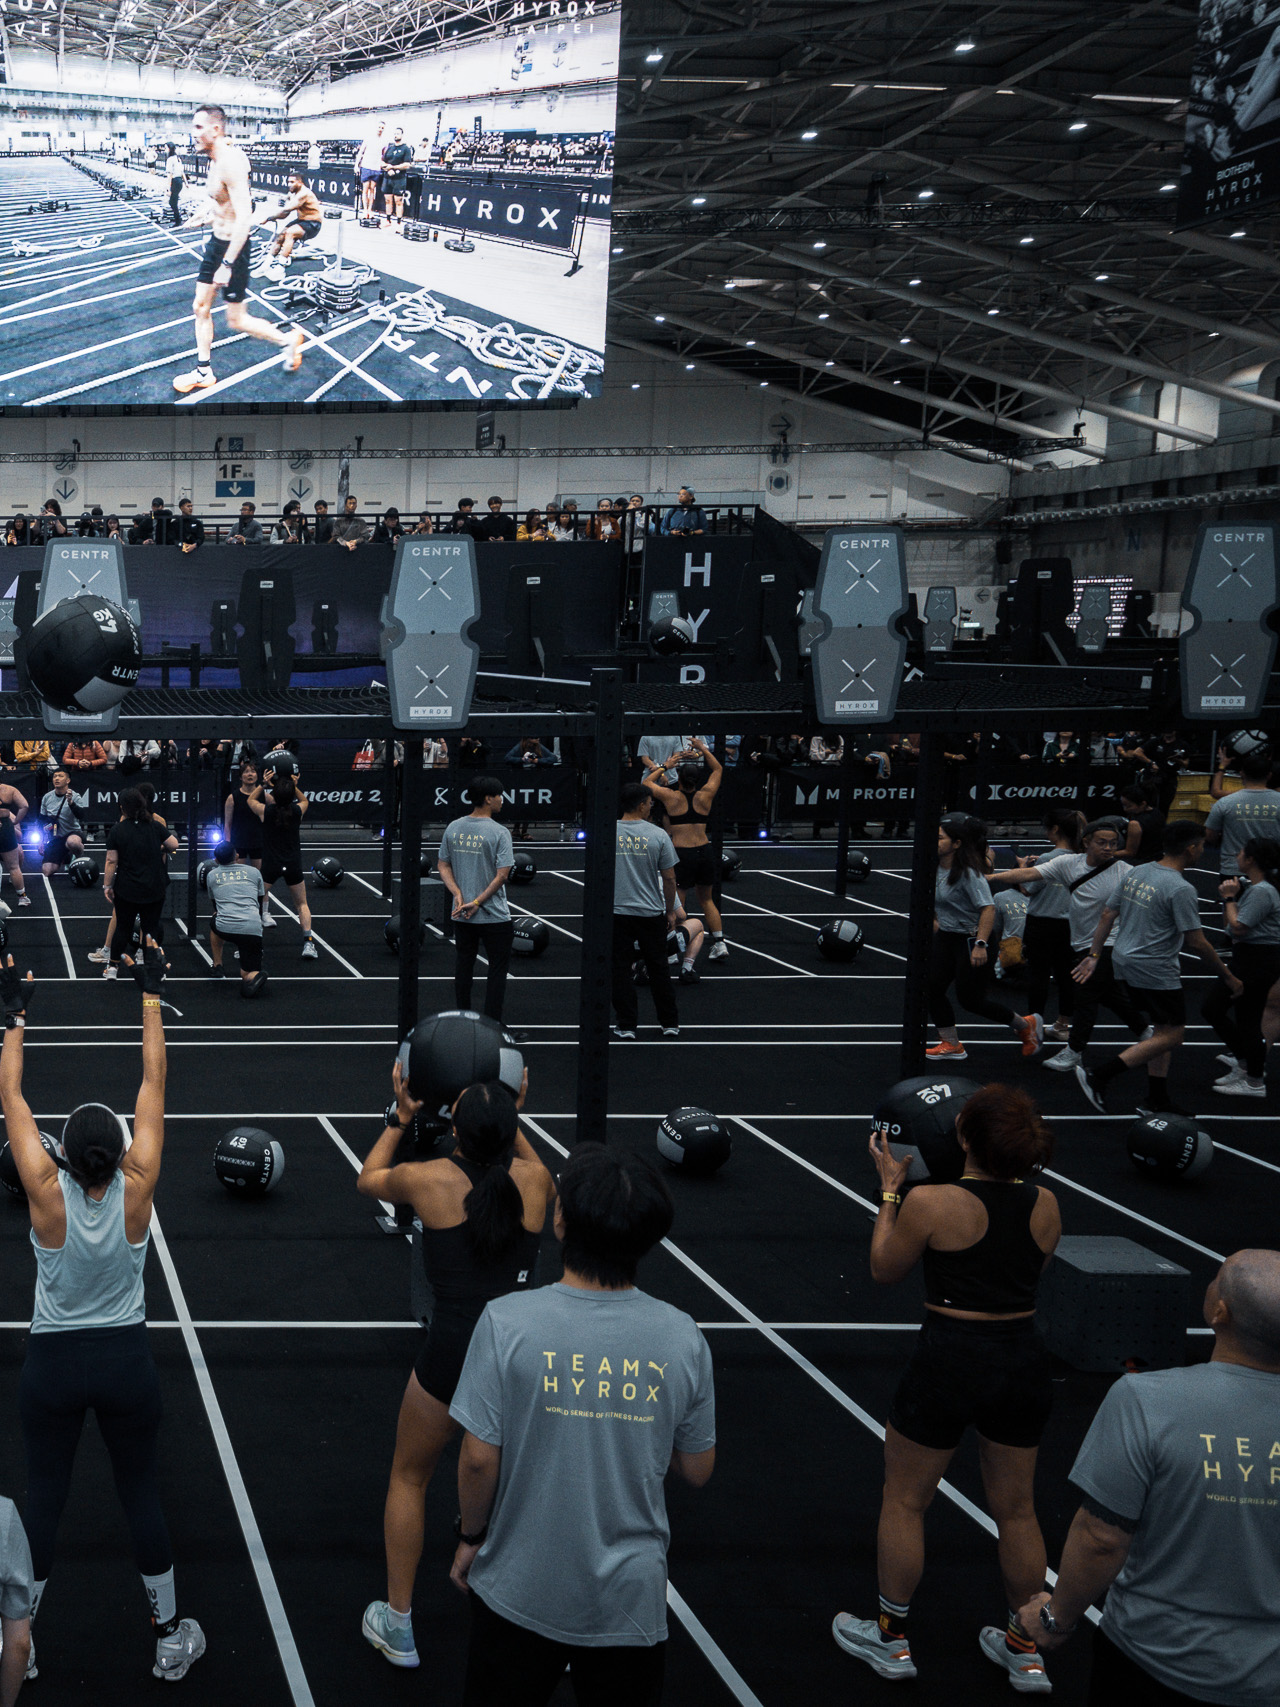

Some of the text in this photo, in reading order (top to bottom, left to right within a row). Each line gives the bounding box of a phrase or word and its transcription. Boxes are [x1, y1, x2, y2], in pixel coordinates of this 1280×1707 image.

[514, 1, 595, 17] HYROX
[512, 23, 594, 35] TAIPEI
[1216, 160, 1255, 181] BIOTHERM
[308, 178, 351, 196] YROX
[1207, 172, 1263, 201] HYROX
[1205, 192, 1260, 215] TAIPEI
[428, 194, 561, 230] HYROX
[219, 464, 242, 478] 1F
[840, 540, 890, 550] CENTR
[1214, 533, 1266, 543] CENTR
[60, 550, 109, 560] CENTR
[412, 547, 461, 557] CENTR
[112, 665, 140, 680] ENTR
[303, 790, 380, 804] ncept 2
[461, 788, 553, 804] CNTR
[826, 788, 916, 801] MPROTEI
[453, 840, 482, 848] HYROX
[917, 1086, 940, 1104] KG
[1176, 1136, 1194, 1169] CENTR
[260, 1148, 271, 1184] CENTR
[542, 1351, 639, 1377] TEAM
[543, 1376, 660, 1402] HYROX
[545, 1406, 569, 1416] WORLD
[570, 1409, 594, 1418] SERIES
[605, 1411, 632, 1420] FITNESS
[1200, 1434, 1280, 1459] TEA
[1203, 1460, 1280, 1484] HYR
[1206, 1492, 1237, 1503] WORLD
